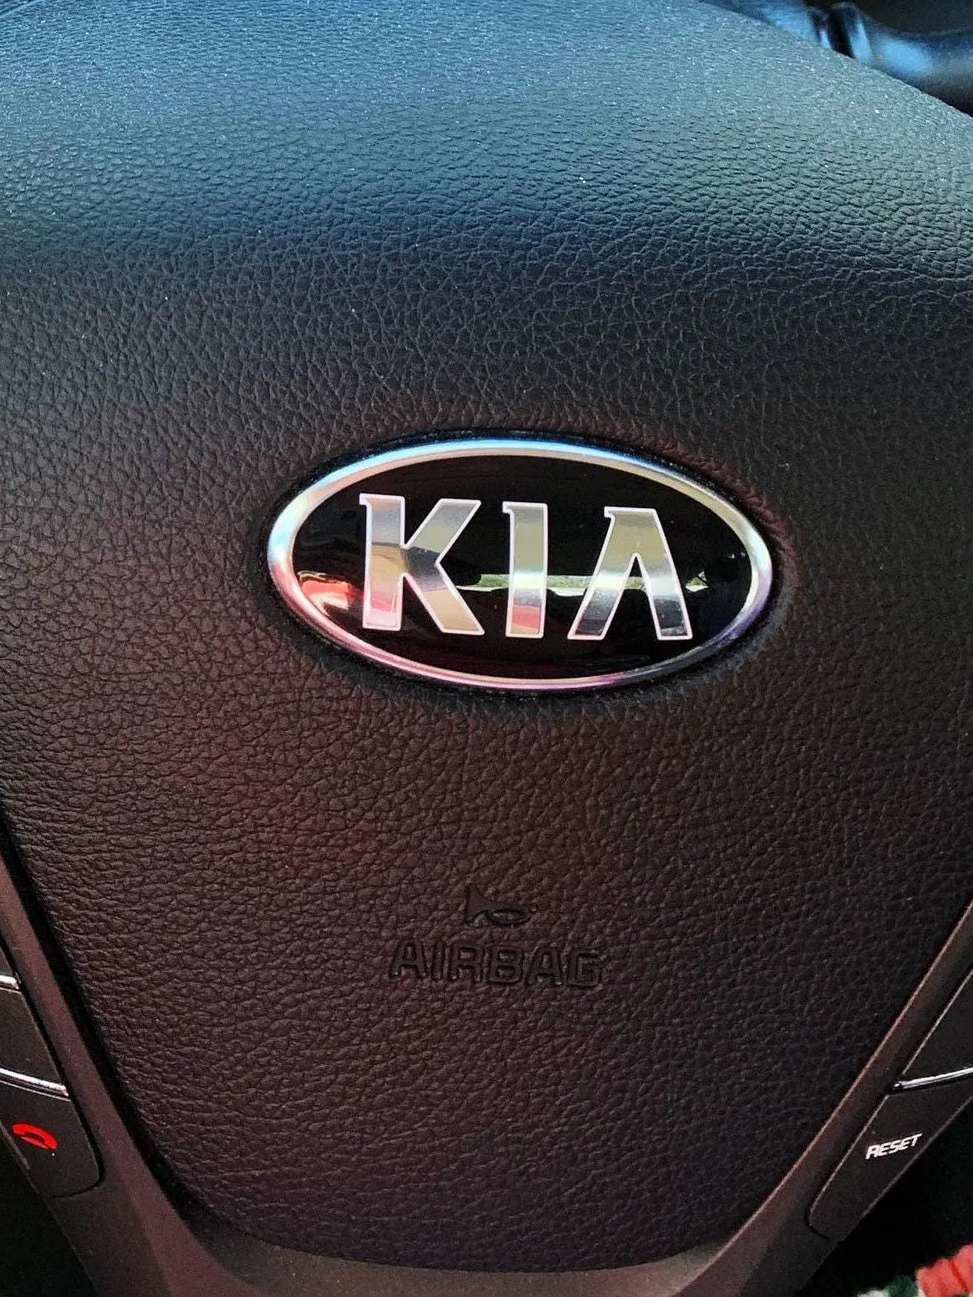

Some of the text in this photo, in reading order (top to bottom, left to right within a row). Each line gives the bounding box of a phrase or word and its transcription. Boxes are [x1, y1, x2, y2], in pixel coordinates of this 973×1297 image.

[359, 493, 693, 641] KIA
[388, 938, 605, 988] AIRBAG
[864, 1133, 923, 1160] RESET
